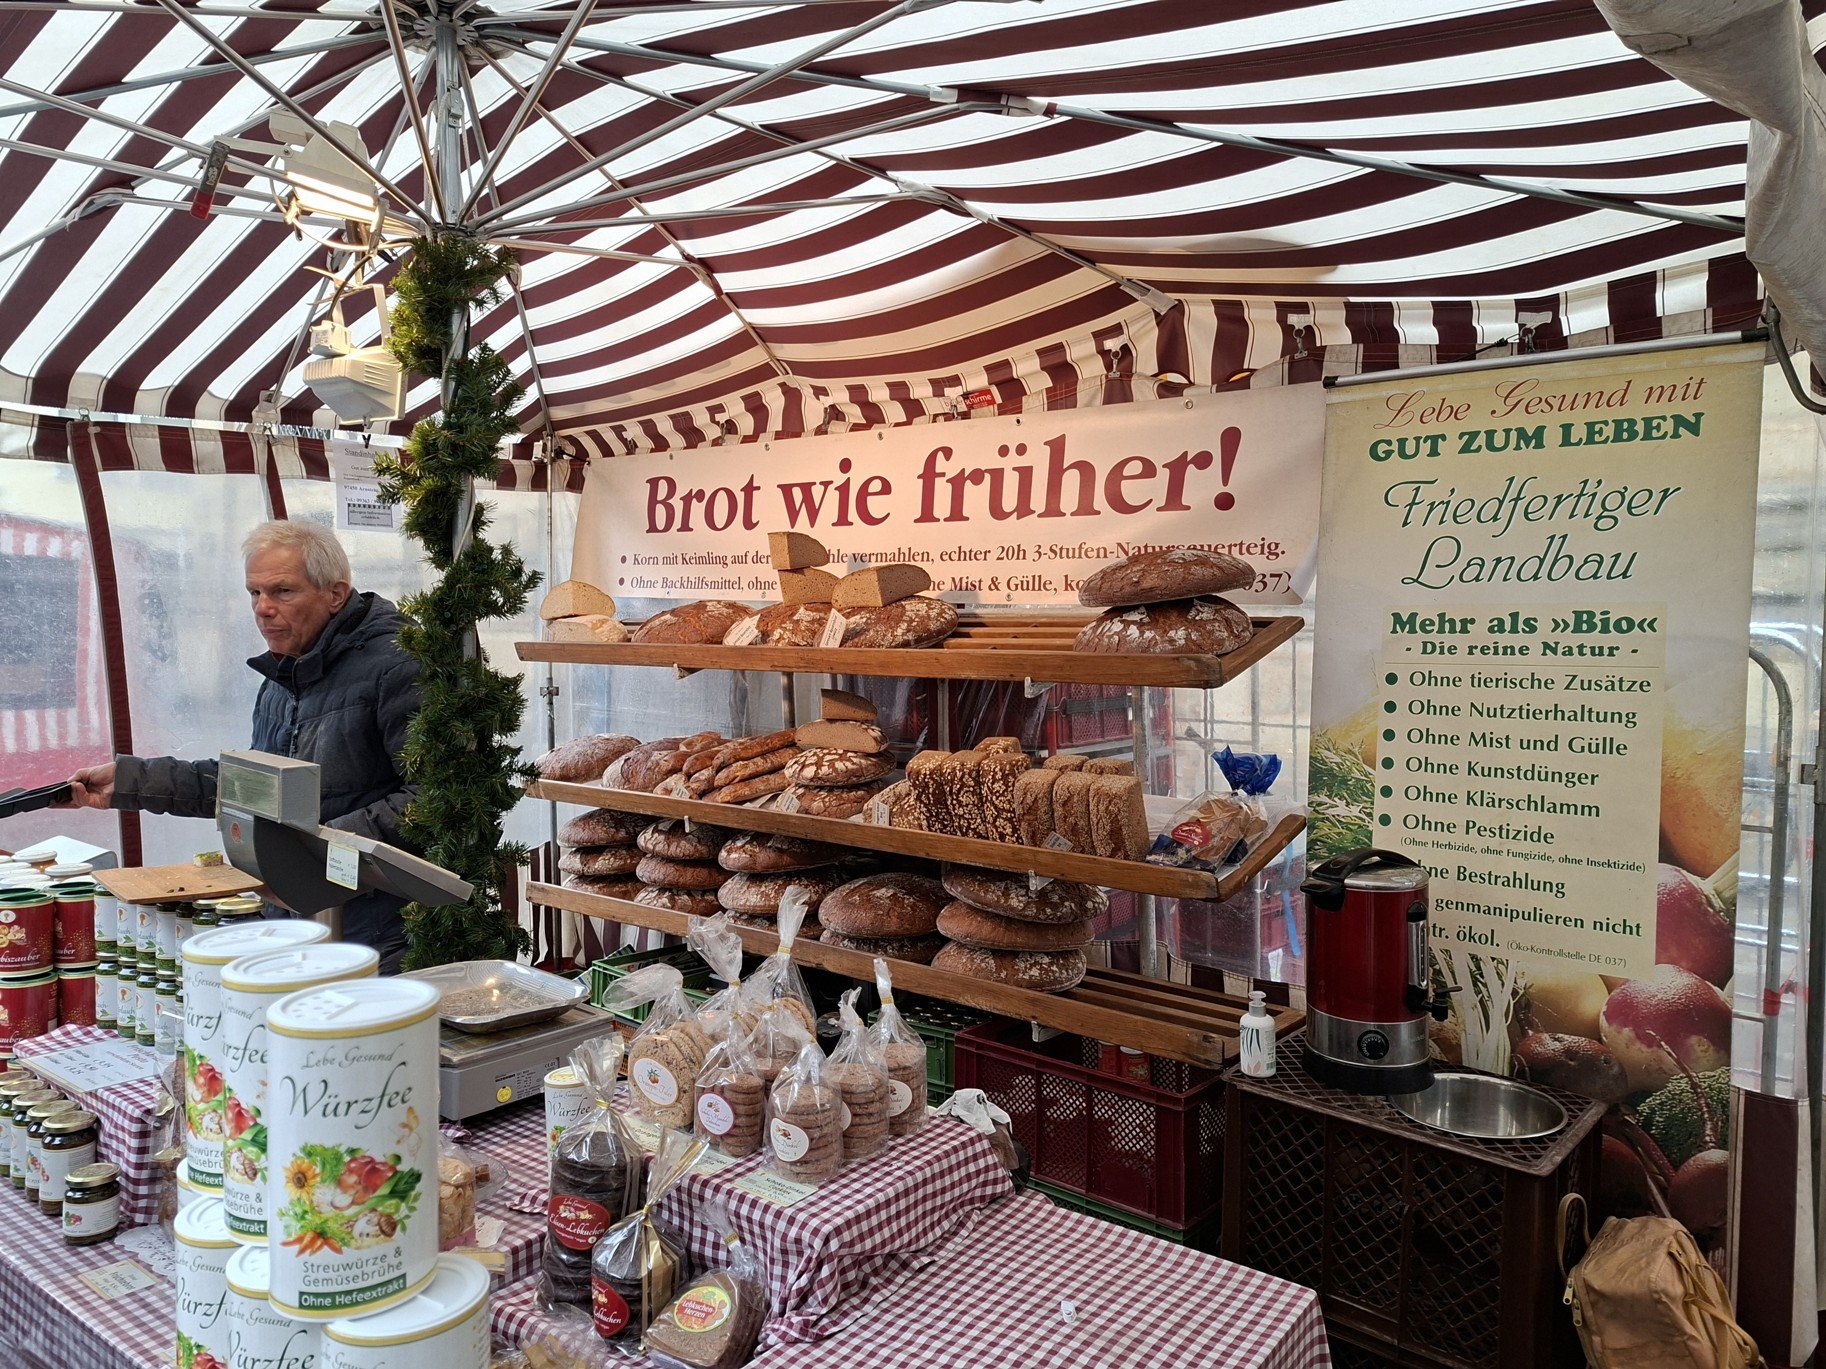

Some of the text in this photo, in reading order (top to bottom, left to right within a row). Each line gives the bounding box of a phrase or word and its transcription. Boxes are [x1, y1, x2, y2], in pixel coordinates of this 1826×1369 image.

[1373, 376, 1707, 429] Lebe Gesund mit
[1369, 412, 1705, 462] GUT ZUM LEBEN
[645, 425, 1242, 534] Brot wie früher!
[1384, 475, 1682, 538] Friedfertiger
[632, 553, 660, 566] Korn
[661, 553, 679, 566] mit
[680, 550, 729, 569] Keimling
[730, 551, 750, 565] auf
[752, 550, 771, 565] der
[852, 547, 935, 567] vermahlen,
[939, 544, 990, 562] echter
[996, 543, 1027, 561] 20h
[1401, 533, 1638, 590] Landbau
[630, 577, 659, 590] Ohne
[661, 576, 744, 593] Backhilfsmittel,
[747, 577, 778, 591] ohne
[950, 576, 984, 592] Mist
[988, 576, 1002, 592] &
[1006, 574, 1058, 595] Gülle,
[1243, 571, 1291, 594] 37)
[1390, 610, 1658, 635] Mehr als »Bio«
[1421, 640, 1458, 656] Die
[1467, 641, 1530, 657] reine
[1541, 641, 1620, 658] Natur
[1409, 670, 1652, 693] Ohne tierische Zusätze
[1407, 699, 1638, 729] Ohne Nutztierhaltung
[1406, 728, 1628, 756] Ohne Mist und Gülle
[1405, 756, 1599, 788] Ohne Kunstdünger
[1404, 785, 1601, 818] Ohne Klärschlamm
[1402, 814, 1555, 844] Ohne Pestizide
[1400, 837, 1646, 875] (Ohne Herbizide, ohne Fungizide, ohne Insektizide)
[1456, 865, 1566, 898] Bestrahlung
[1434, 898, 1643, 938] genmanipulieren nicht
[1456, 924, 1500, 947] ökol.
[1506, 940, 1586, 963] (Öko-Kontrollstelle
[1589, 952, 1603, 965] DE
[1605, 955, 1627, 969] 037)
[192, 971, 221, 989] Gesun
[301, 1044, 404, 1071] Lebe Gesund
[280, 1061, 413, 1130] Würzfee
[548, 1097, 591, 1121] Würzfee
[255, 1192, 263, 1203] &
[189, 1255, 226, 1274] Gesun
[302, 1248, 404, 1275] Streuwürze &
[302, 1261, 403, 1289] Gemüsebrühe
[301, 1279, 404, 1308] Ohne Hefeextrakt
[684, 1308, 706, 1318] Herzen
